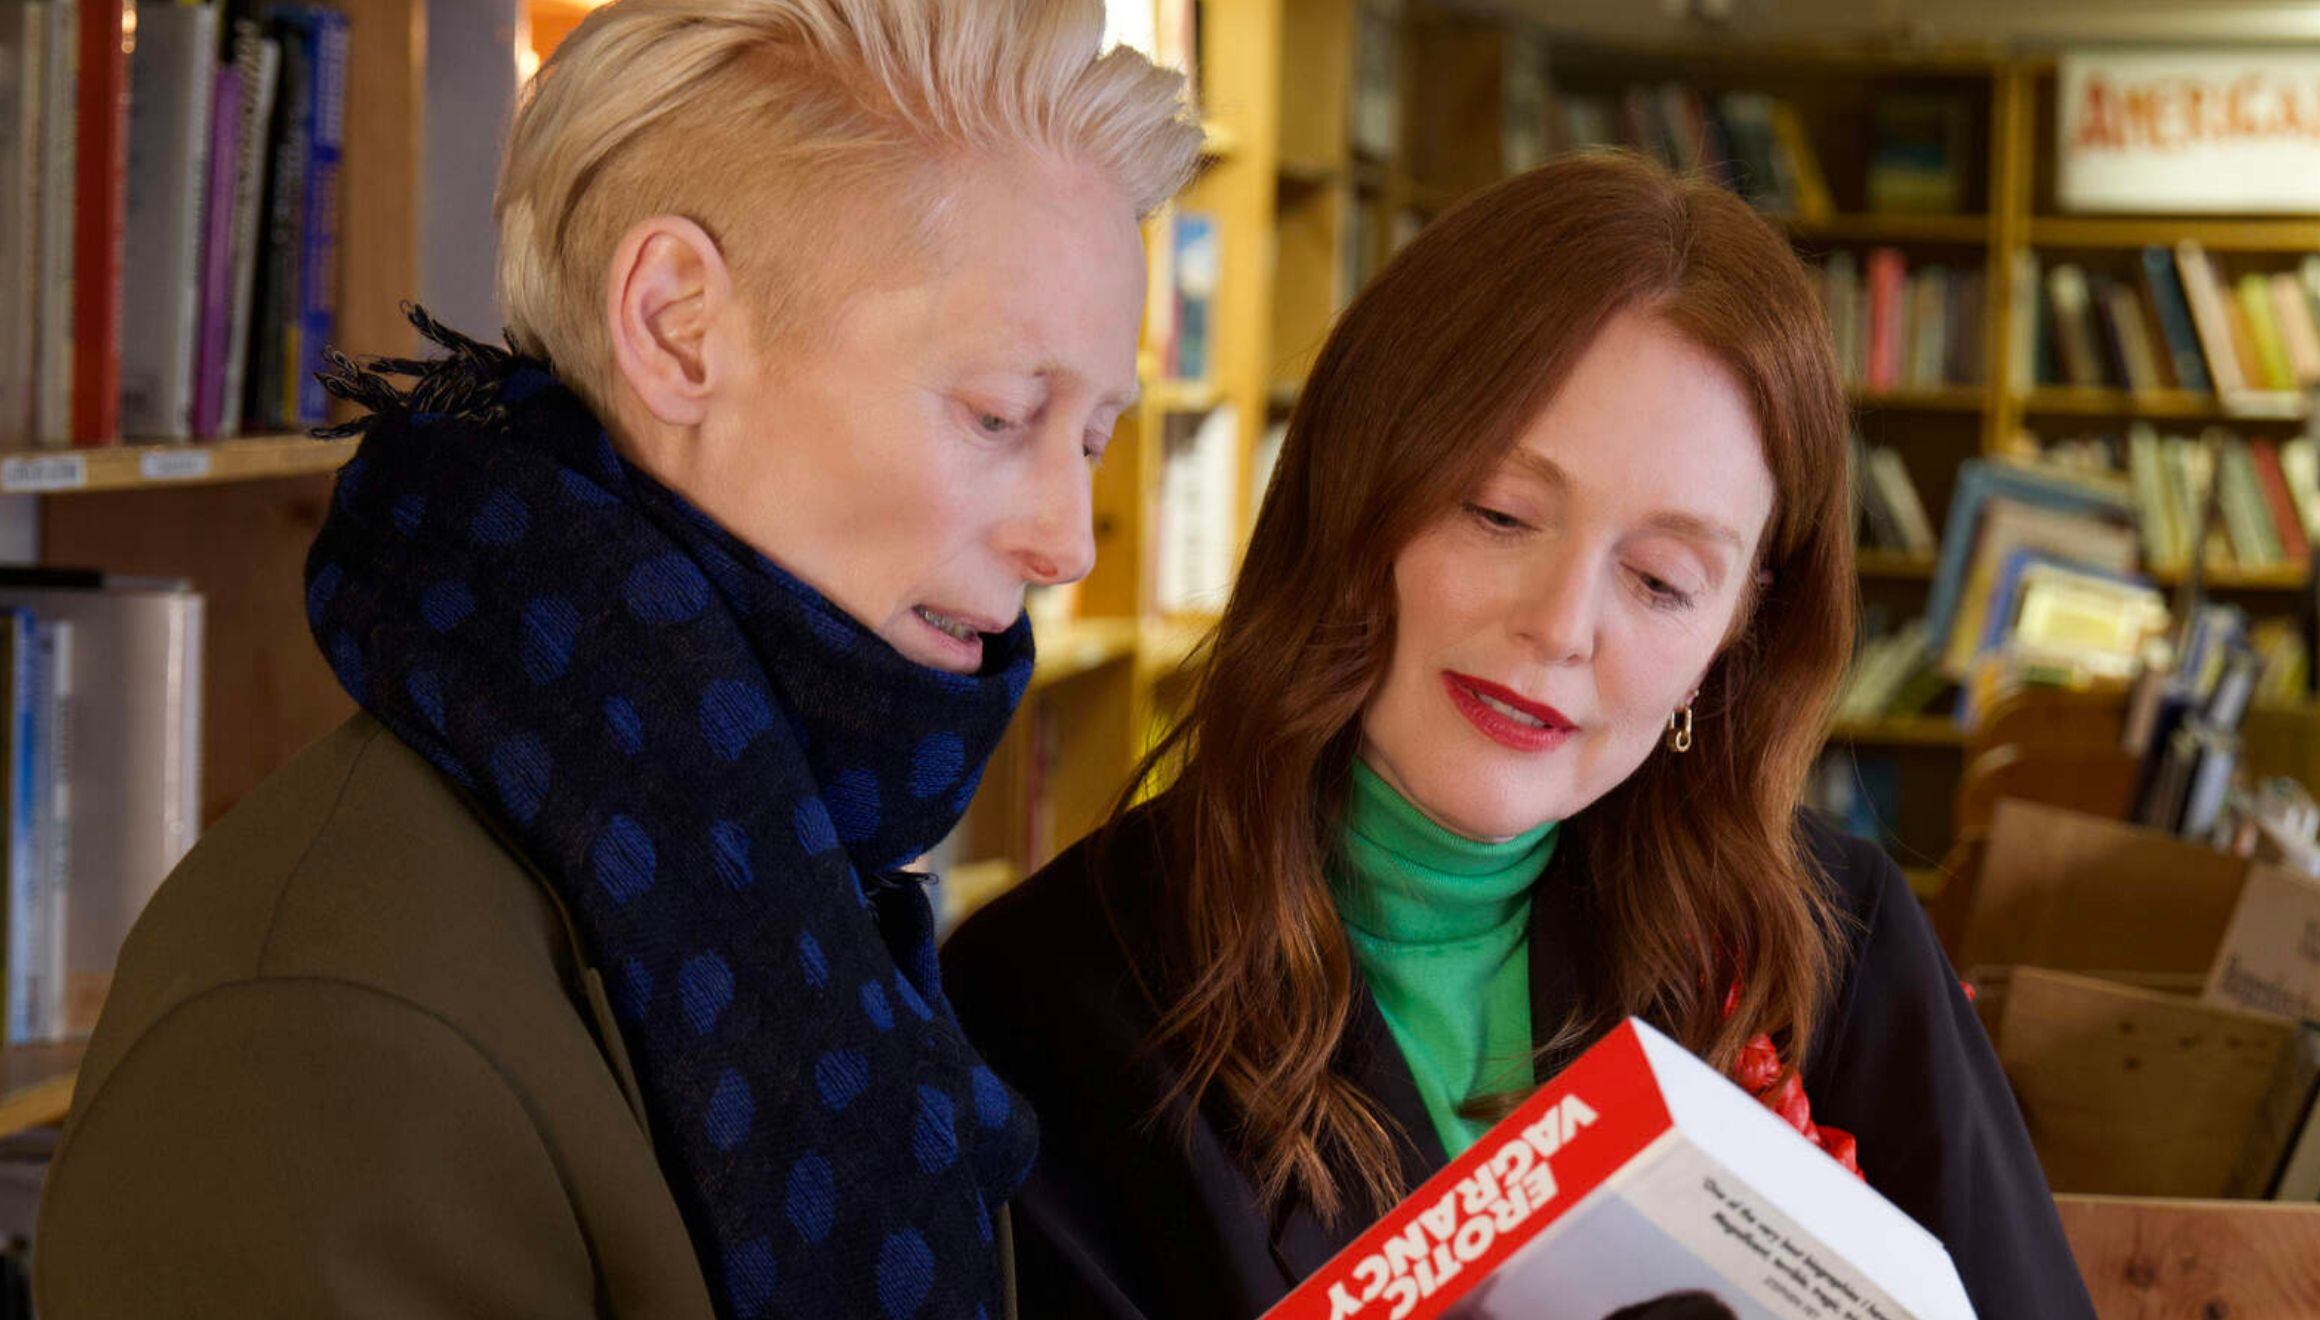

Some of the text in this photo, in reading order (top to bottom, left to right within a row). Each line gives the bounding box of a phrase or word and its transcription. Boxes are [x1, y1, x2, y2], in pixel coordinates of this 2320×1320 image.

[1328, 1093, 1598, 1320] VAGRANCY
[1382, 1161, 1558, 1320] EROTIC
[1740, 1208, 1755, 1223] the
[1758, 1223, 1780, 1242] very
[1781, 1239, 1804, 1258] best
[1803, 1255, 1860, 1302] biographies
